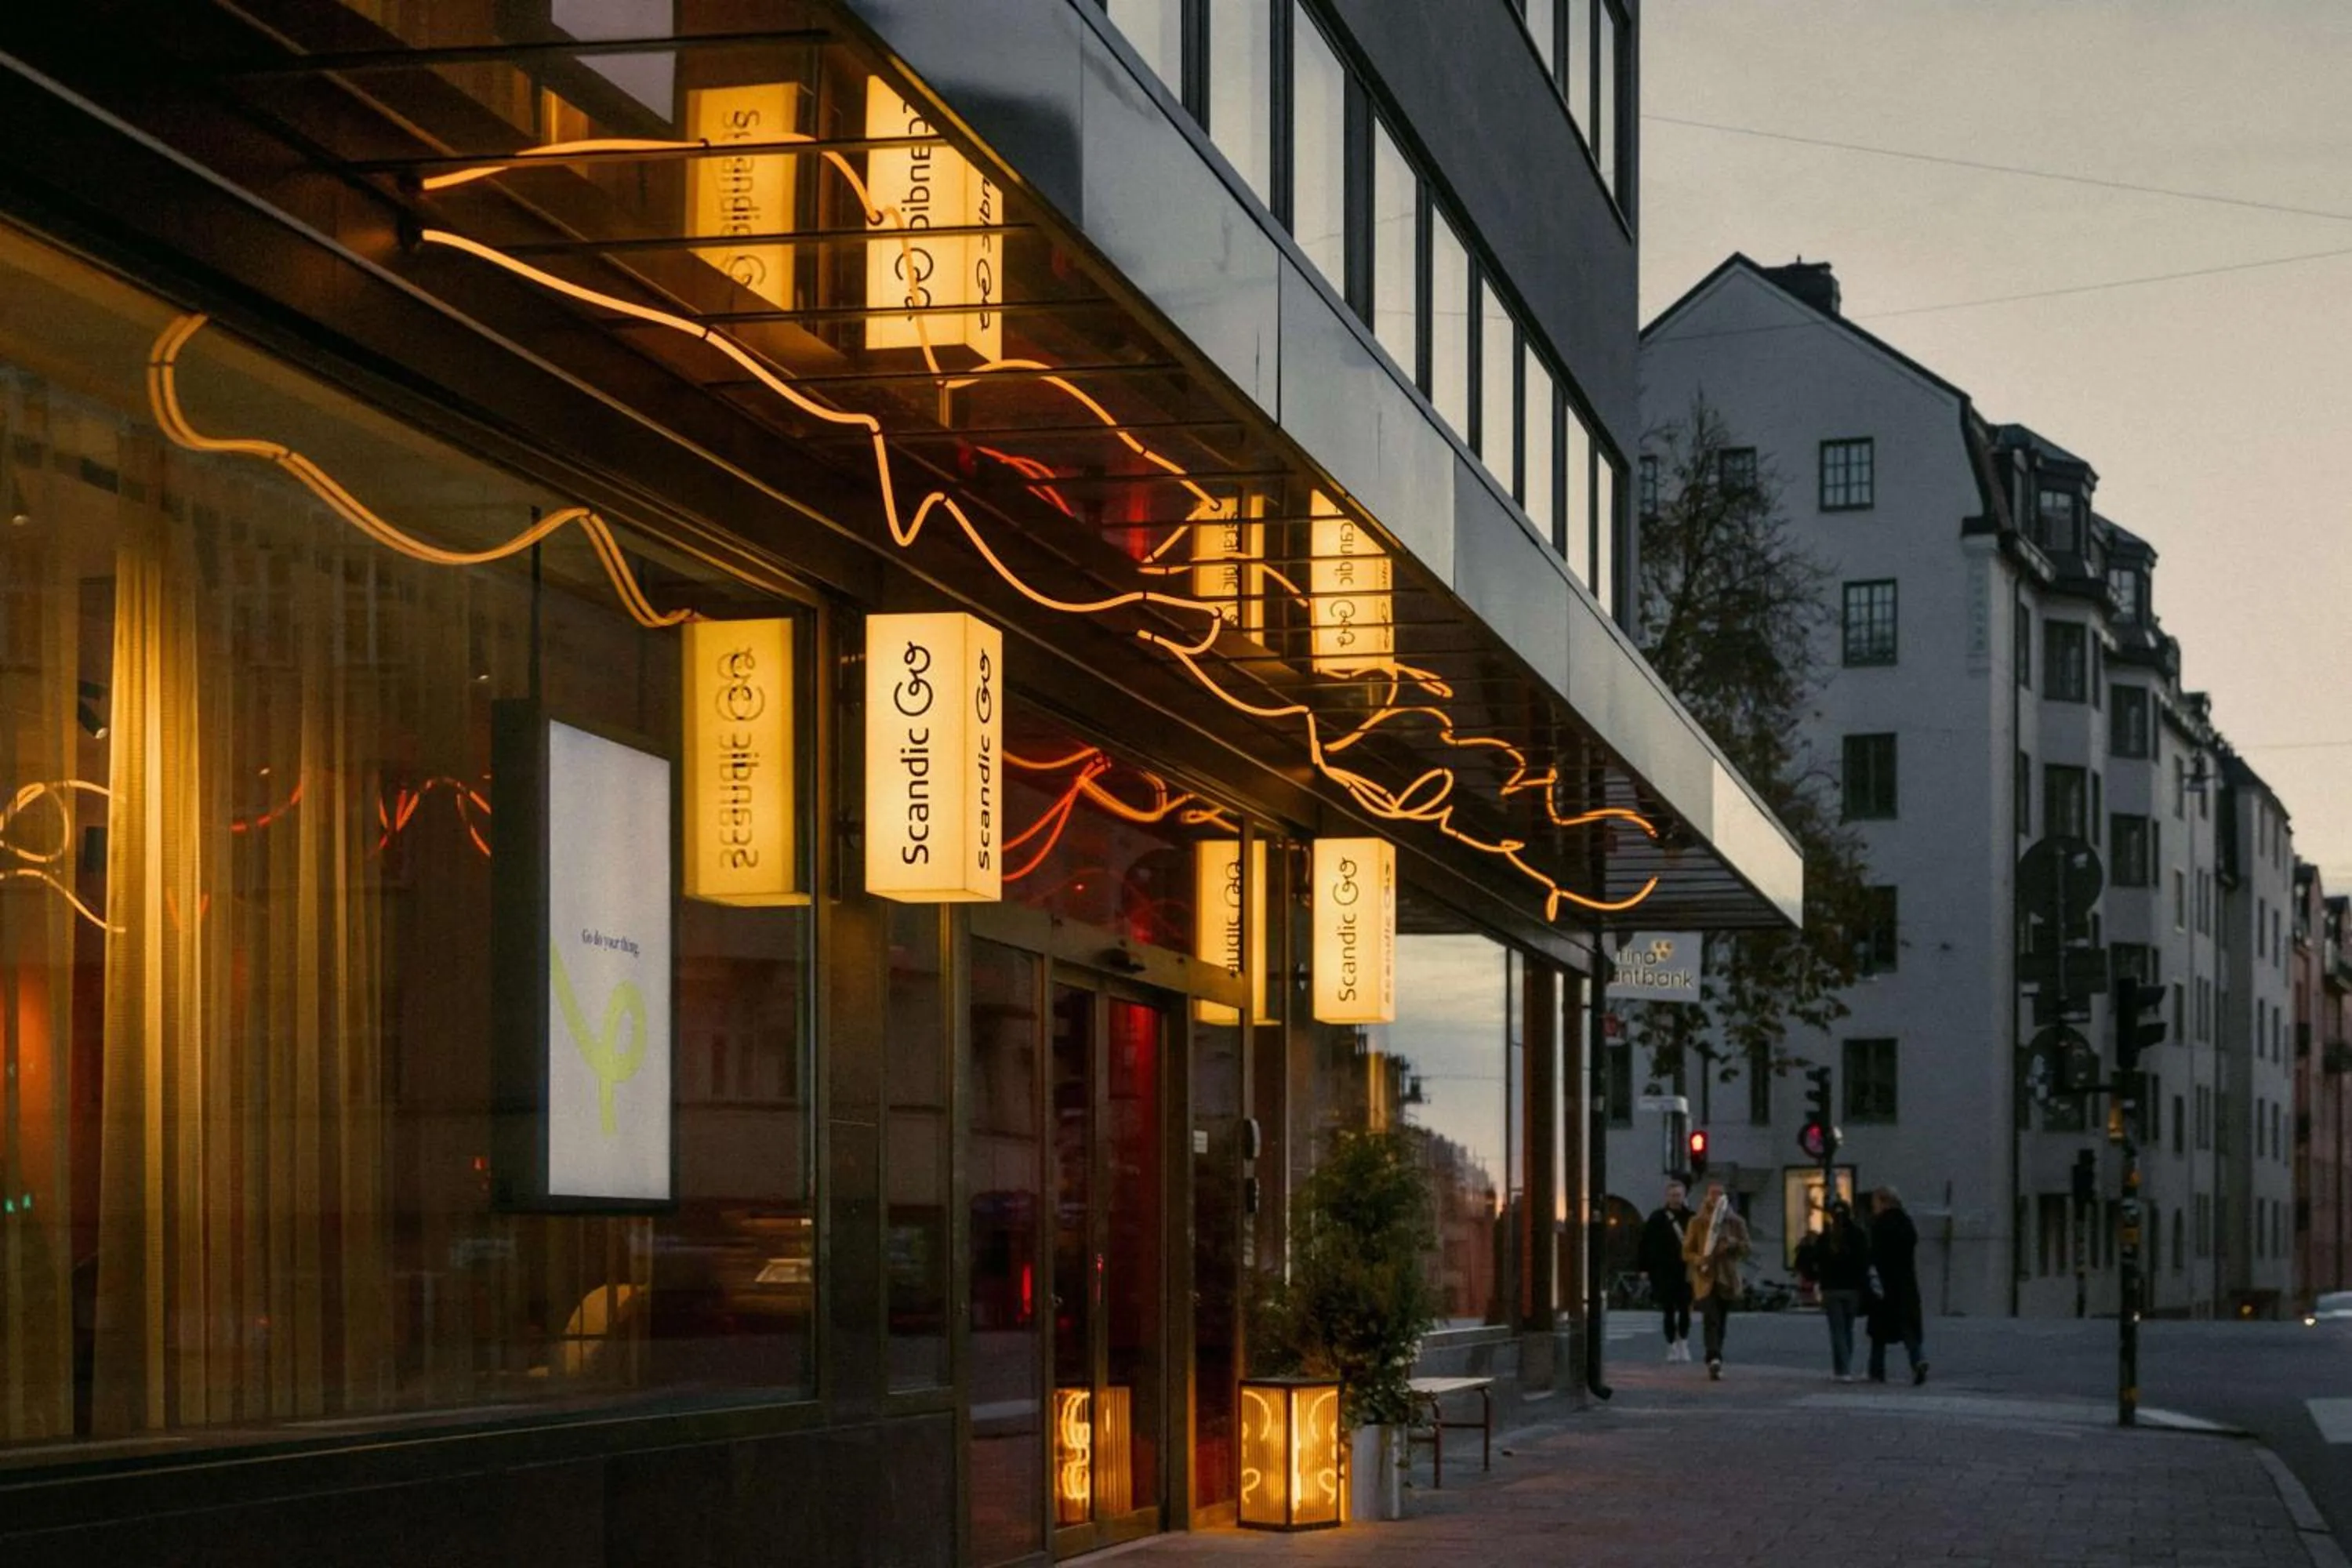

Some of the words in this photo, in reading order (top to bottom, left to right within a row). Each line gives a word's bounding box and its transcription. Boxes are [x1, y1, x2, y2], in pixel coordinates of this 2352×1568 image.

[894, 641, 933, 717] Go
[976, 648, 992, 724] Go
[901, 728, 929, 865] Scandic
[977, 734, 991, 871] Scandic
[1332, 857, 1358, 906] Go
[1337, 913, 1356, 1002] Scandic
